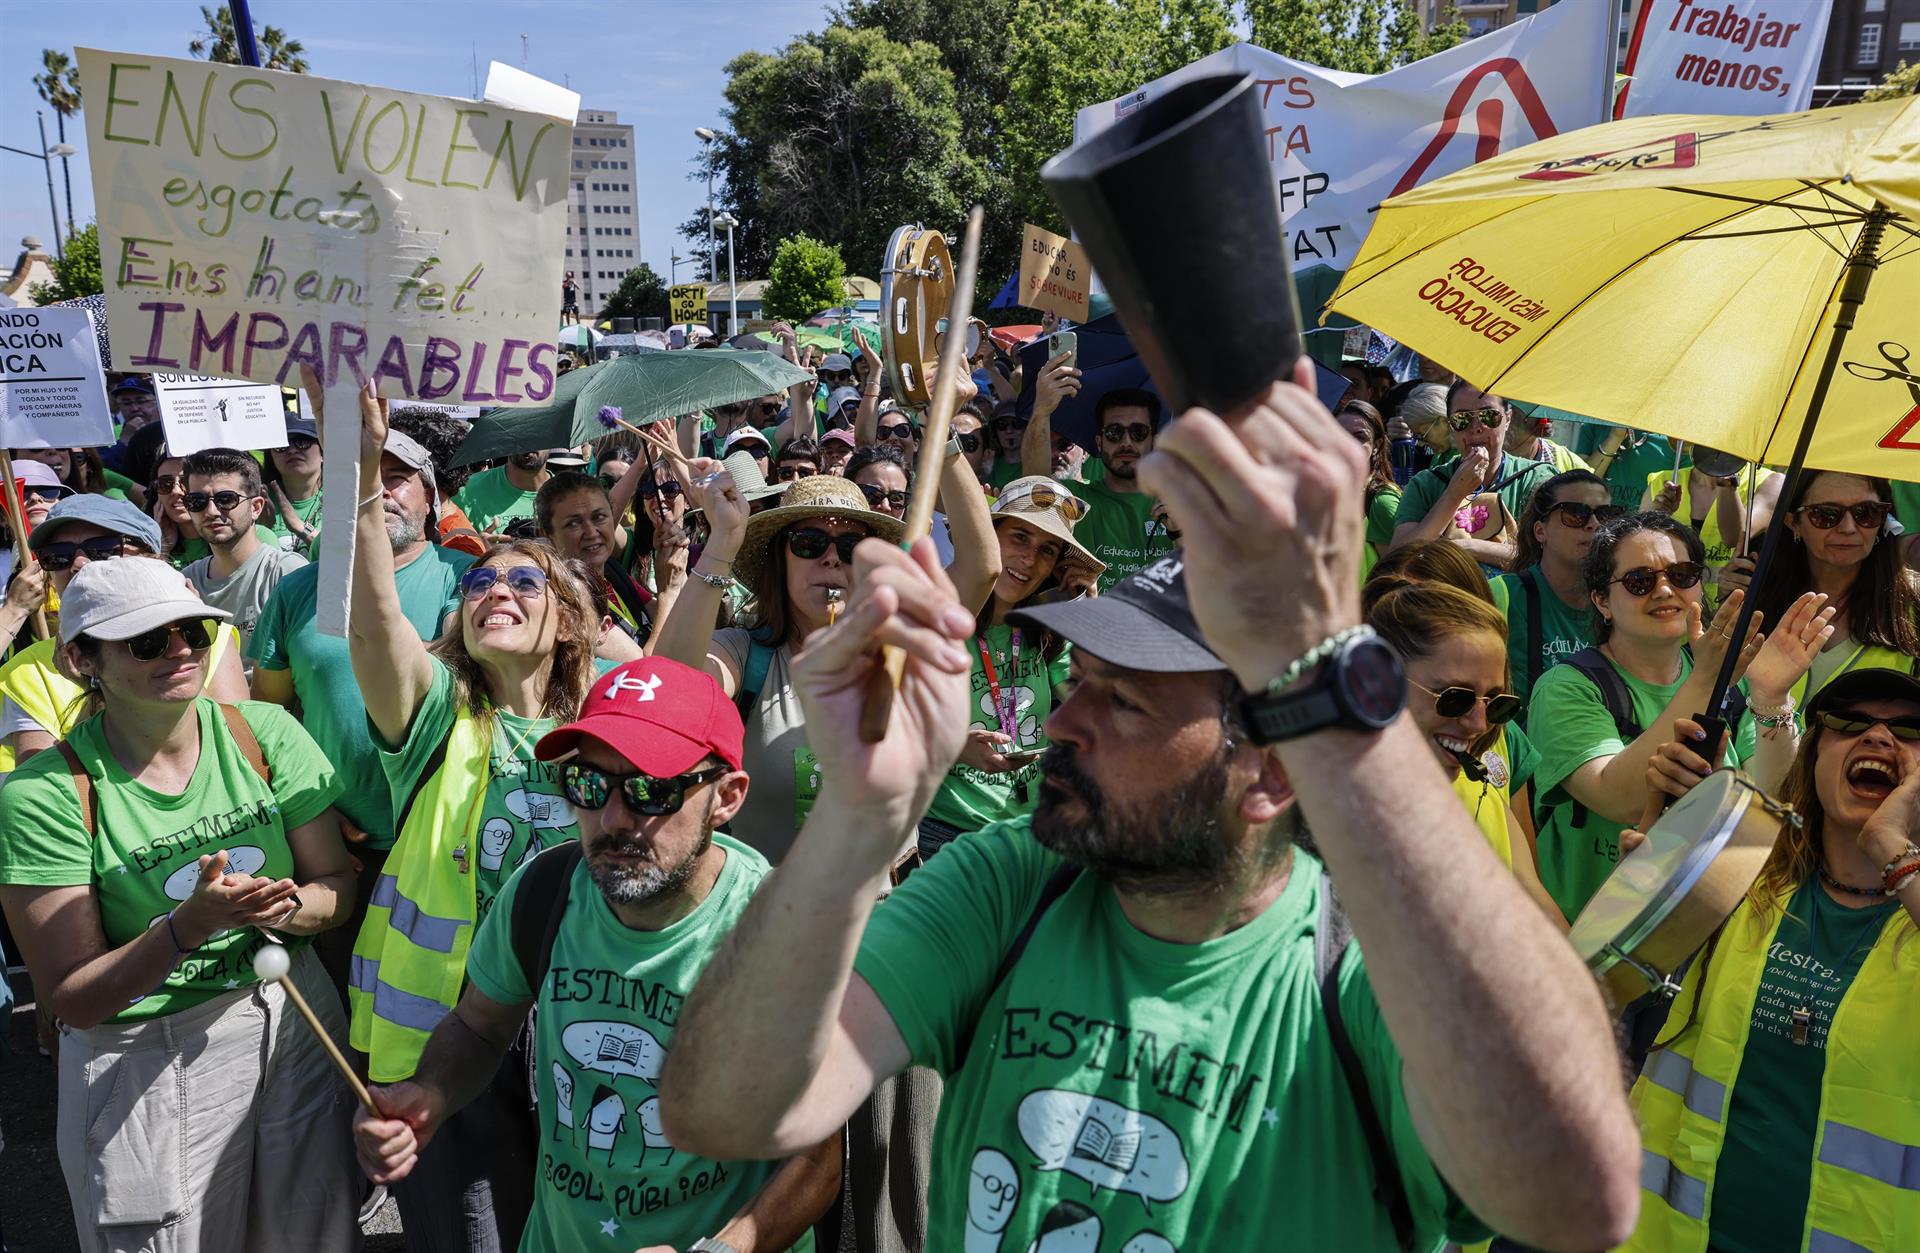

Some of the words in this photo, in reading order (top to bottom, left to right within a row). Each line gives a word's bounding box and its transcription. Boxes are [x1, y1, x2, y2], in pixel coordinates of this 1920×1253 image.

[1669, 0, 1800, 52] Trabajar
[1676, 53, 1791, 97] menos,
[104, 63, 278, 161] ENS
[320, 90, 555, 202] VOLEN
[116, 237, 229, 297] Ens
[246, 235, 362, 306] han
[671, 287, 704, 299] ORTI
[1030, 276, 1082, 304] SOBREVIURE
[681, 300, 694, 309] GO
[675, 308, 707, 322] HOME
[130, 302, 556, 402] IMPARABLES
[158, 373, 185, 383] SON
[34, 402, 82, 410] COMPAÑERAS
[1103, 545, 1140, 558] Educació
[128, 799, 272, 874] ESTIMEM
[1774, 986, 1801, 999] posa
[1760, 994, 1786, 1009] cada
[1755, 1007, 1776, 1019] que
